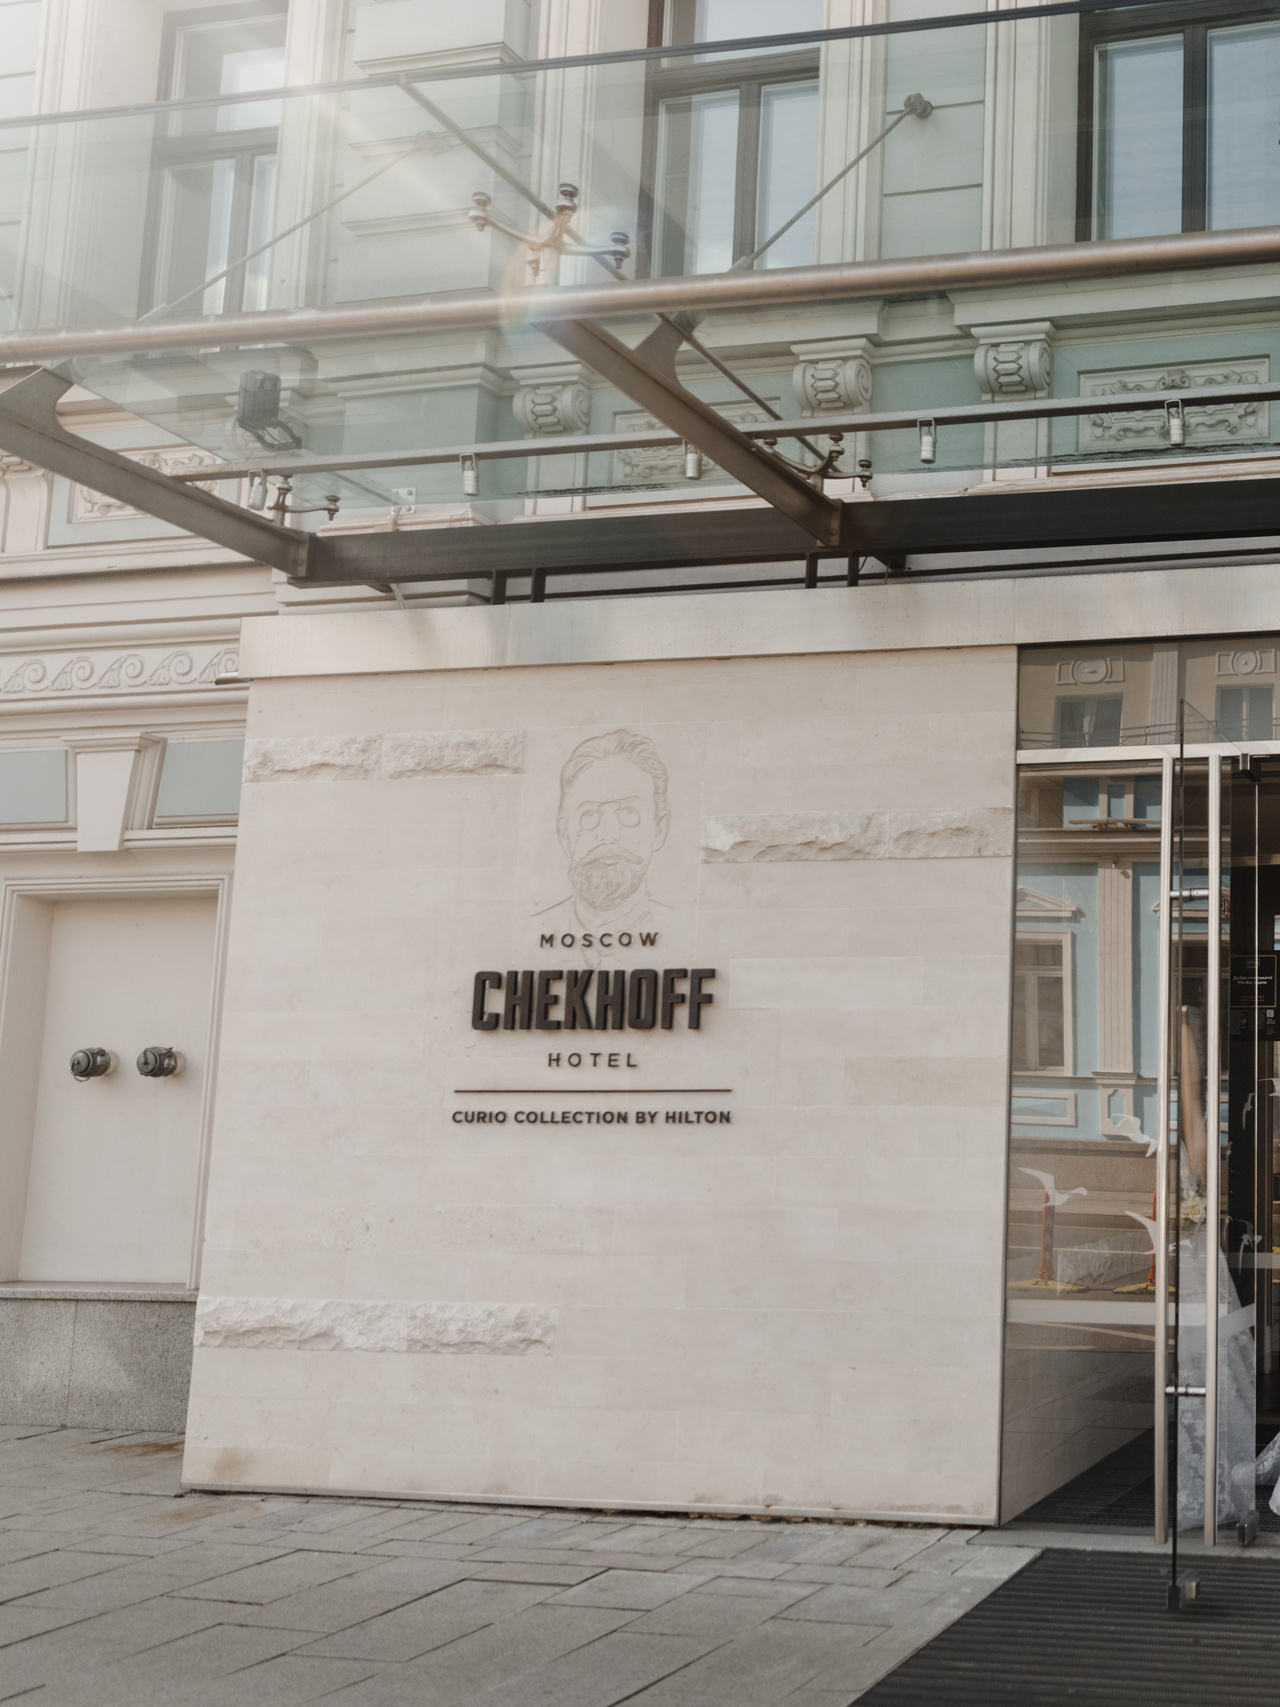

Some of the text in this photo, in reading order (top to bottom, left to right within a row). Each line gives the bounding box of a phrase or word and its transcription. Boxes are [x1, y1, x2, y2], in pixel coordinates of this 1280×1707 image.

[540, 932, 659, 948] MOSCOW
[471, 968, 717, 1031] CHEKHOFF
[548, 1053, 638, 1068] HOTEL
[452, 1110, 731, 1124] CURIO COLLECTION BY HILTON
